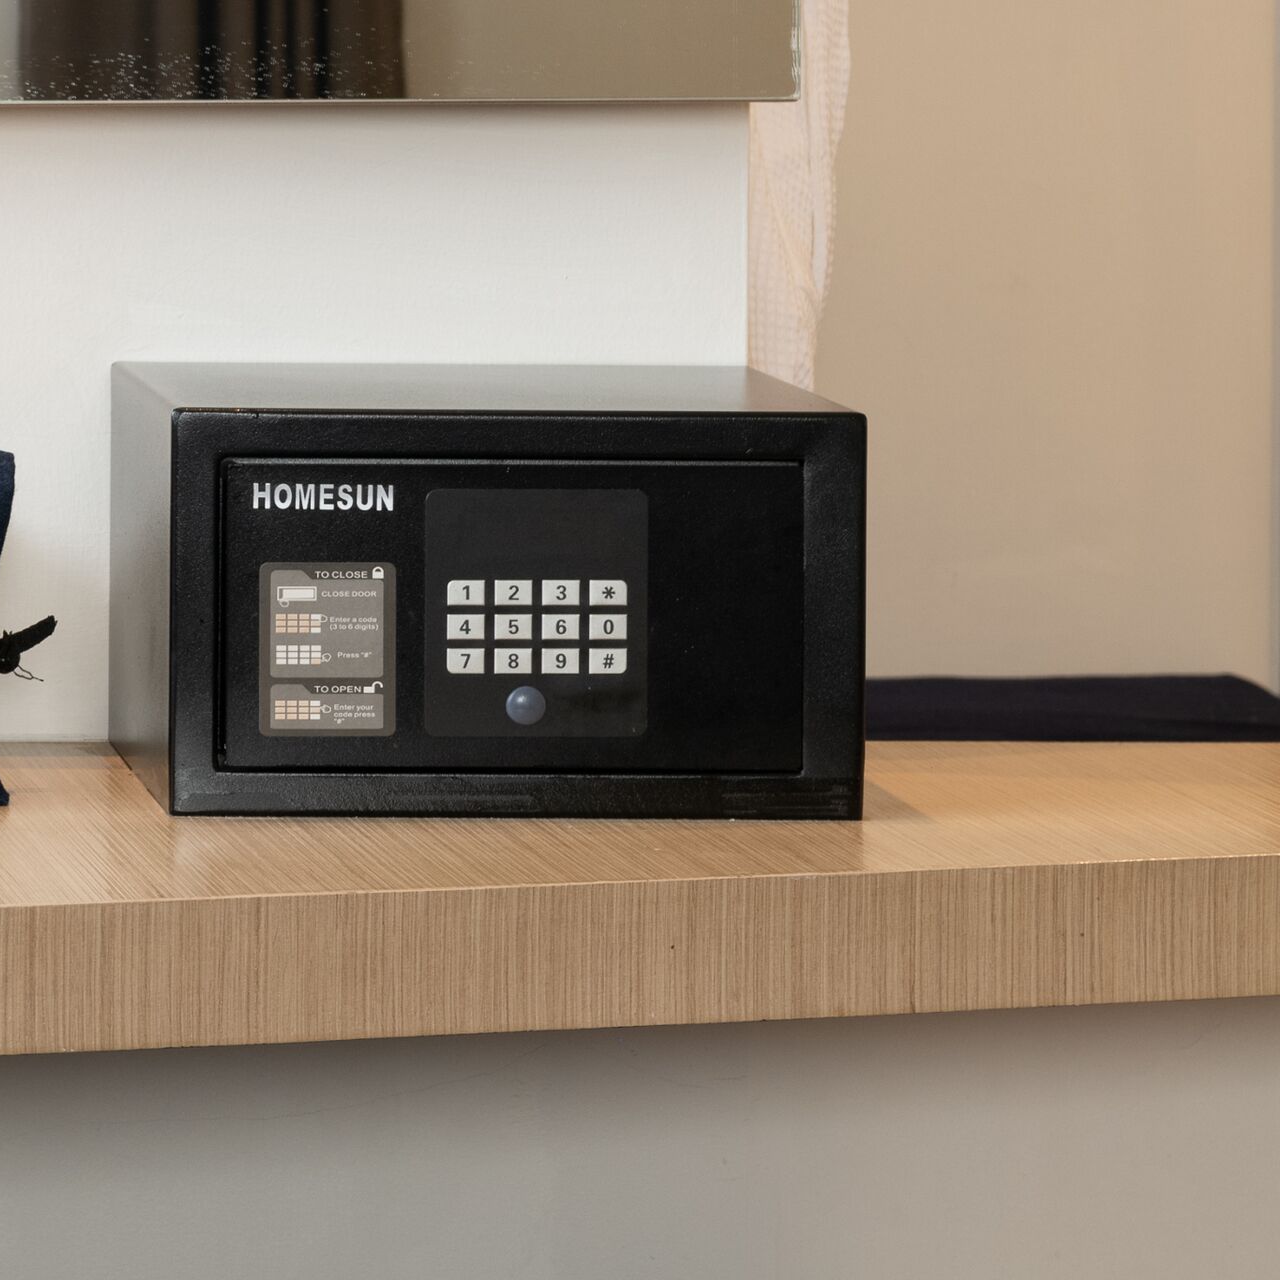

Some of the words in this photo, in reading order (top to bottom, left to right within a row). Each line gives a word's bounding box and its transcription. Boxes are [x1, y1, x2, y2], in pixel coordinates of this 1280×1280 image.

[252, 483, 395, 511] HOMESUN
[315, 570, 330, 579] TO
[332, 570, 368, 579] CLOSE
[461, 585, 471, 600] 1
[507, 585, 520, 600] 2
[555, 585, 567, 601] 3
[330, 623, 338, 631] (3
[354, 623, 379, 631] digits)
[459, 619, 471, 635] 4
[508, 619, 520, 635] 5
[555, 619, 568, 635] 6
[460, 653, 471, 669] 7
[508, 653, 520, 669] 8
[555, 653, 567, 669] 9
